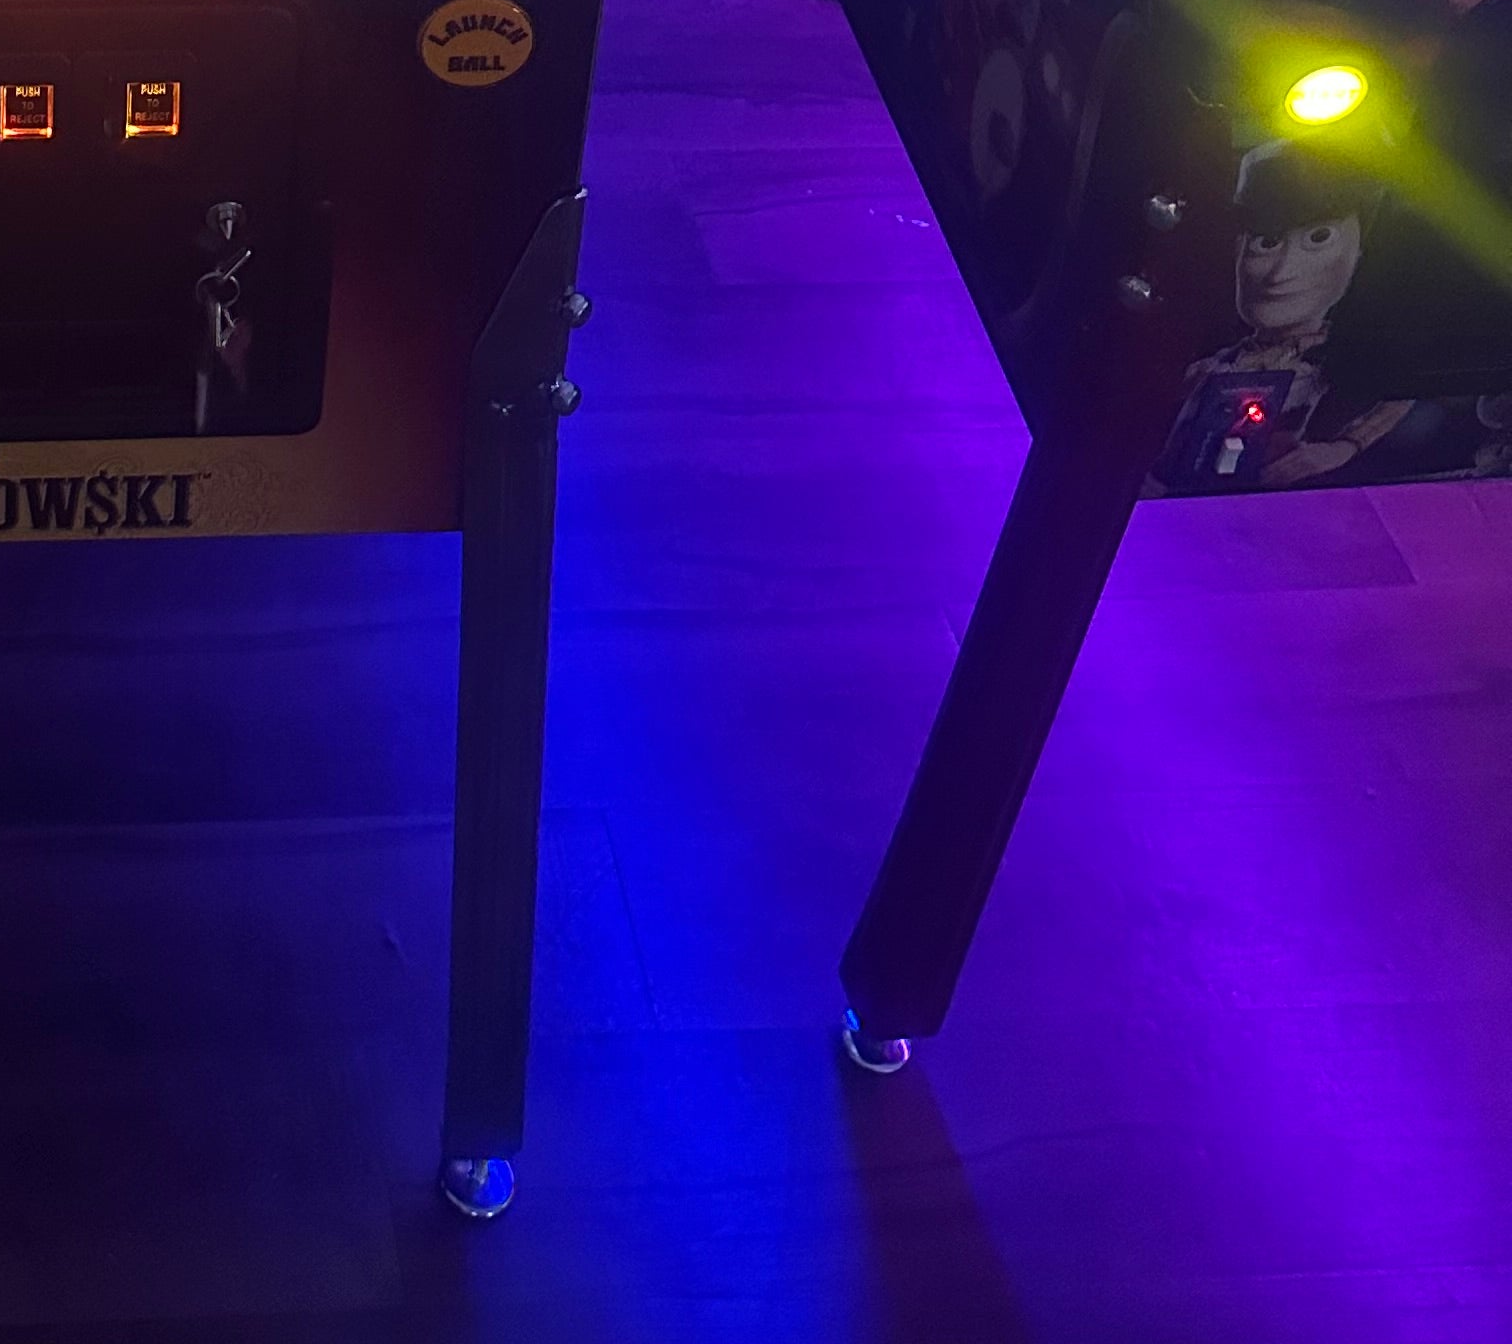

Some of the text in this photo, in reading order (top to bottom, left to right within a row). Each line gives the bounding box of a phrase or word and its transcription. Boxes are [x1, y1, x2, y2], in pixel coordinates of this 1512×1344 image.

[428, 14, 529, 46] LAUNCH
[448, 55, 505, 73] BALL
[15, 86, 41, 97] PUSH
[141, 83, 167, 95] PUSH
[21, 101, 35, 110] TO
[147, 98, 160, 108] TO
[10, 113, 46, 123] REJECT
[135, 111, 170, 121] REJECT
